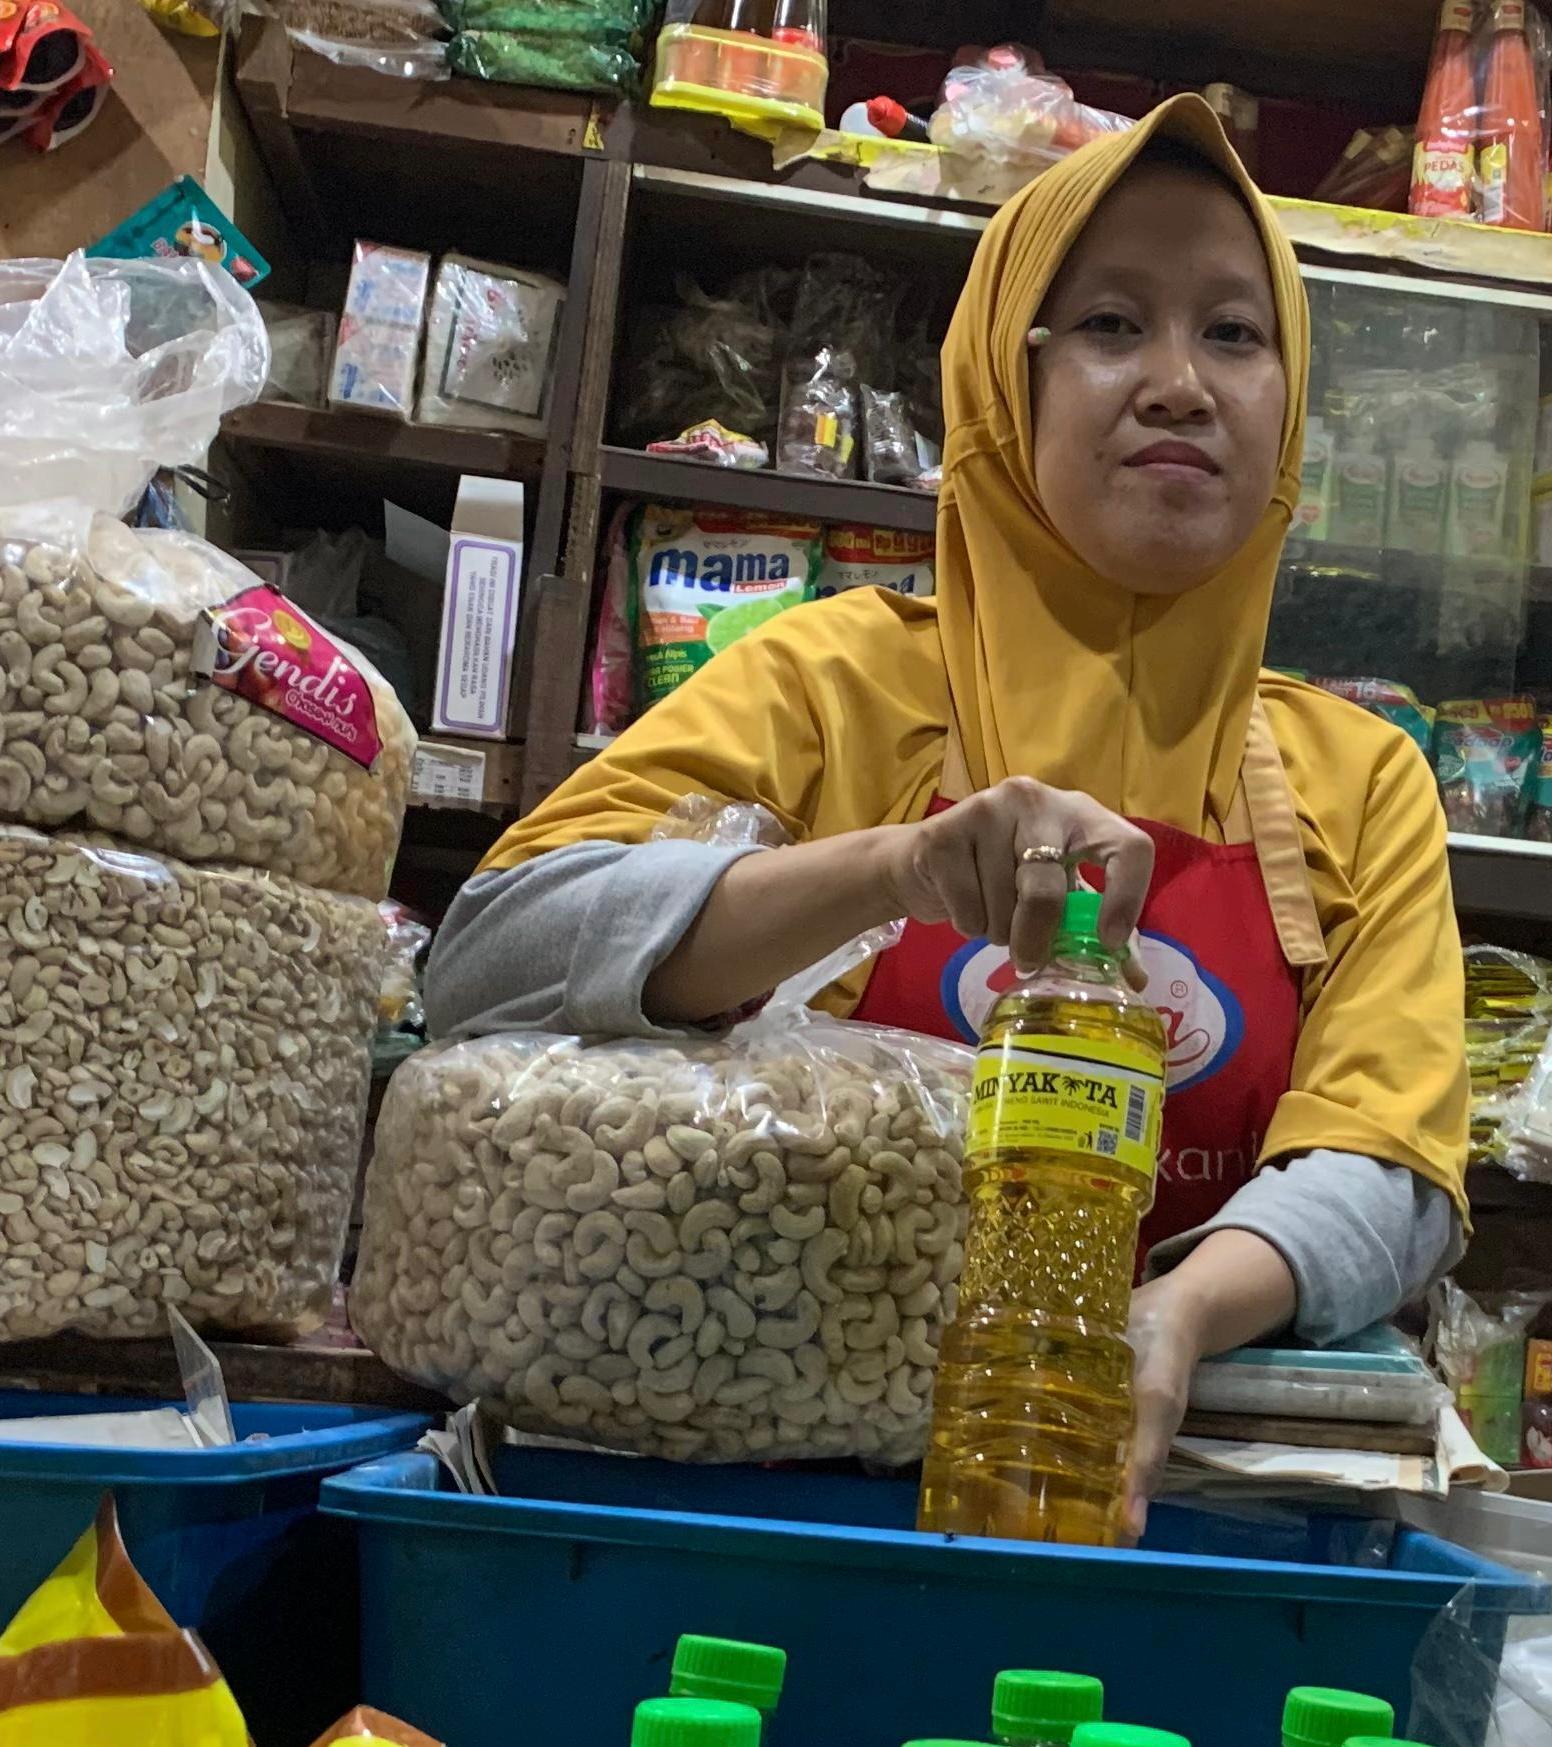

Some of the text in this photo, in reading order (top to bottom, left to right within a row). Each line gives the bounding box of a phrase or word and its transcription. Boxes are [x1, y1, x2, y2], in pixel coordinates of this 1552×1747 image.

[1424, 160, 1465, 173] PEDAS
[649, 547, 790, 593] mama
[734, 579, 789, 594] Lemon
[211, 606, 358, 717] Gendis
